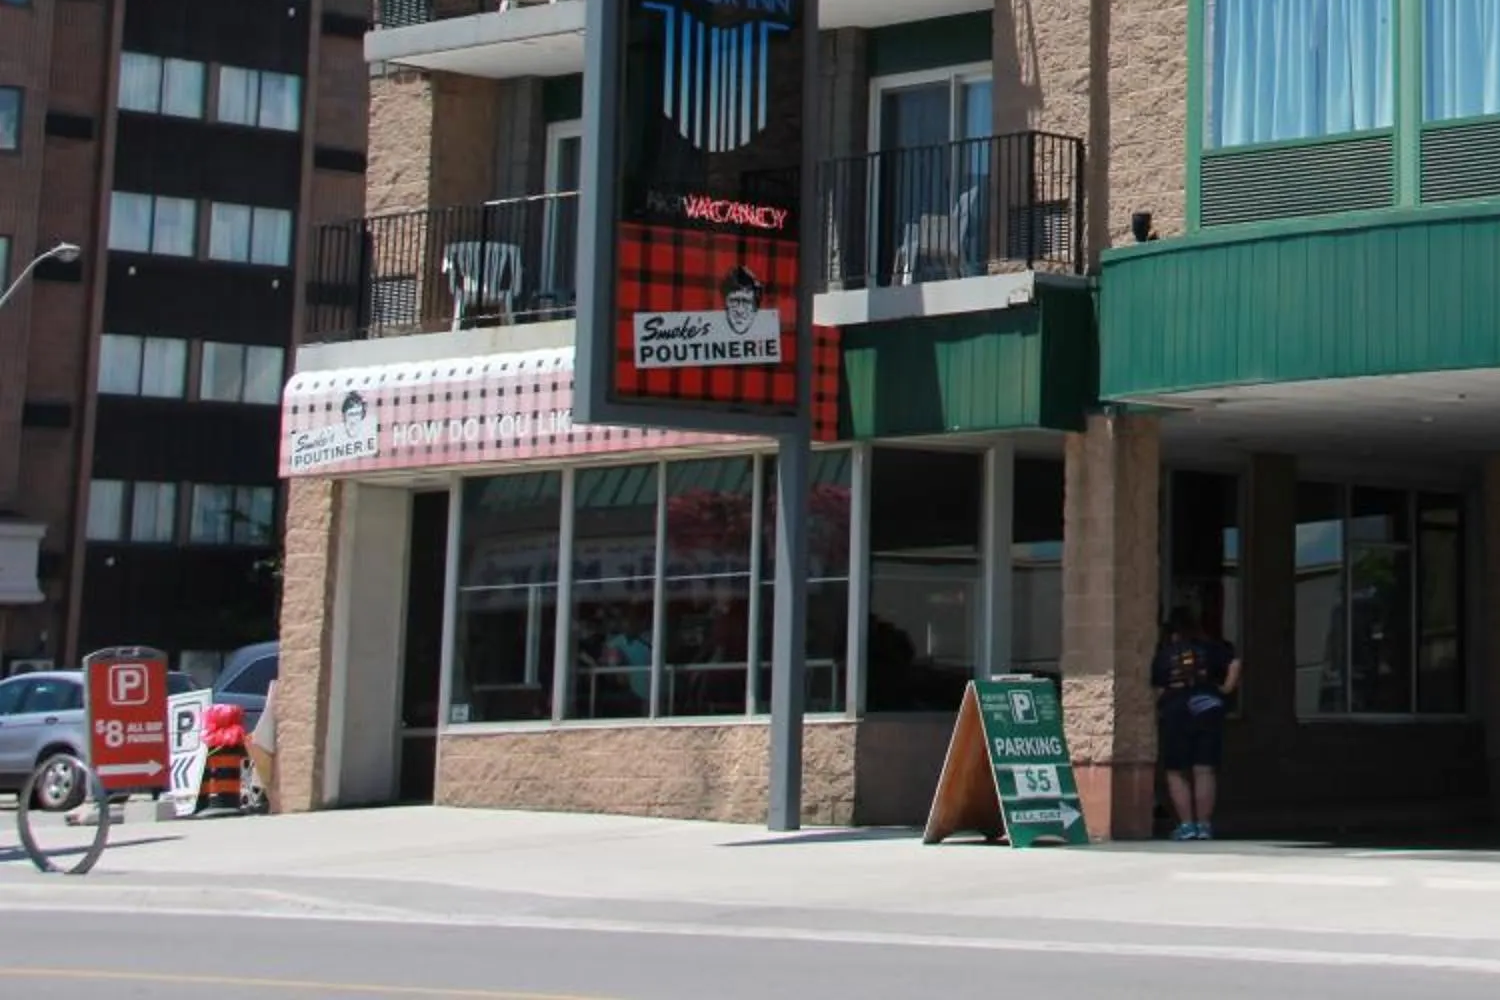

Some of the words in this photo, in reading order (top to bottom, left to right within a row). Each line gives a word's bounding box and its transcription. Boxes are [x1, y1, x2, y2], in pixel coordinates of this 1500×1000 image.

[683, 193, 787, 230] VACANCY
[641, 316, 712, 342] Smoke's
[392, 421, 442, 447] HOW
[449, 419, 480, 442] DO
[486, 413, 529, 438] YOU
[537, 409, 573, 434] LIK
[294, 437, 375, 468] POUTINERE
[117, 669, 141, 701] P
[1012, 692, 1031, 721] P
[176, 710, 195, 747] P
[994, 737, 1062, 756] PARKING
[1025, 767, 1052, 793] $5
